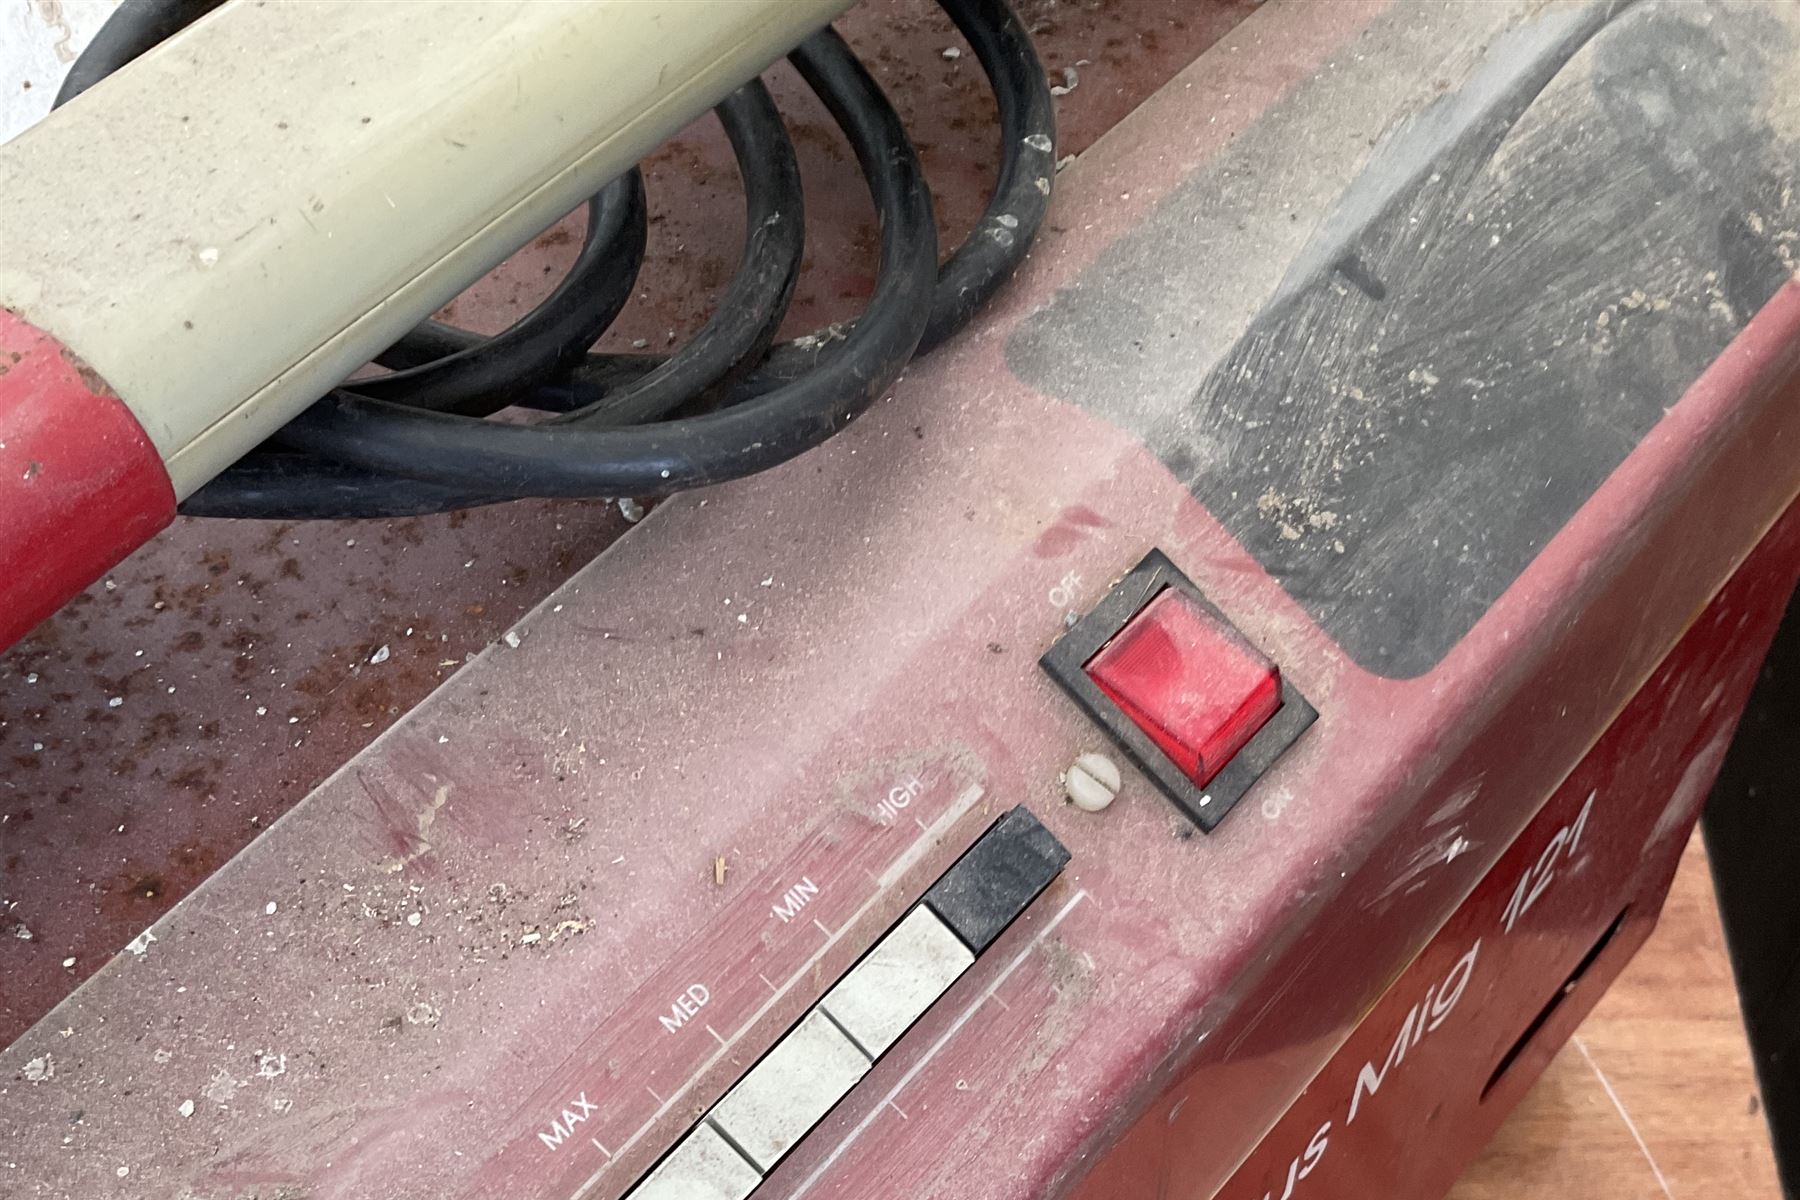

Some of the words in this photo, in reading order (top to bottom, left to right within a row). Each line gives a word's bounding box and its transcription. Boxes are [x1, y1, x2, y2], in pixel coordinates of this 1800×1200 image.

[876, 774, 923, 826] HIGH
[771, 877, 820, 923] MIN
[1346, 937, 1482, 1127] Mig
[1500, 788, 1597, 935] 121
[658, 983, 710, 1034] MED
[537, 1092, 599, 1151] MAX
